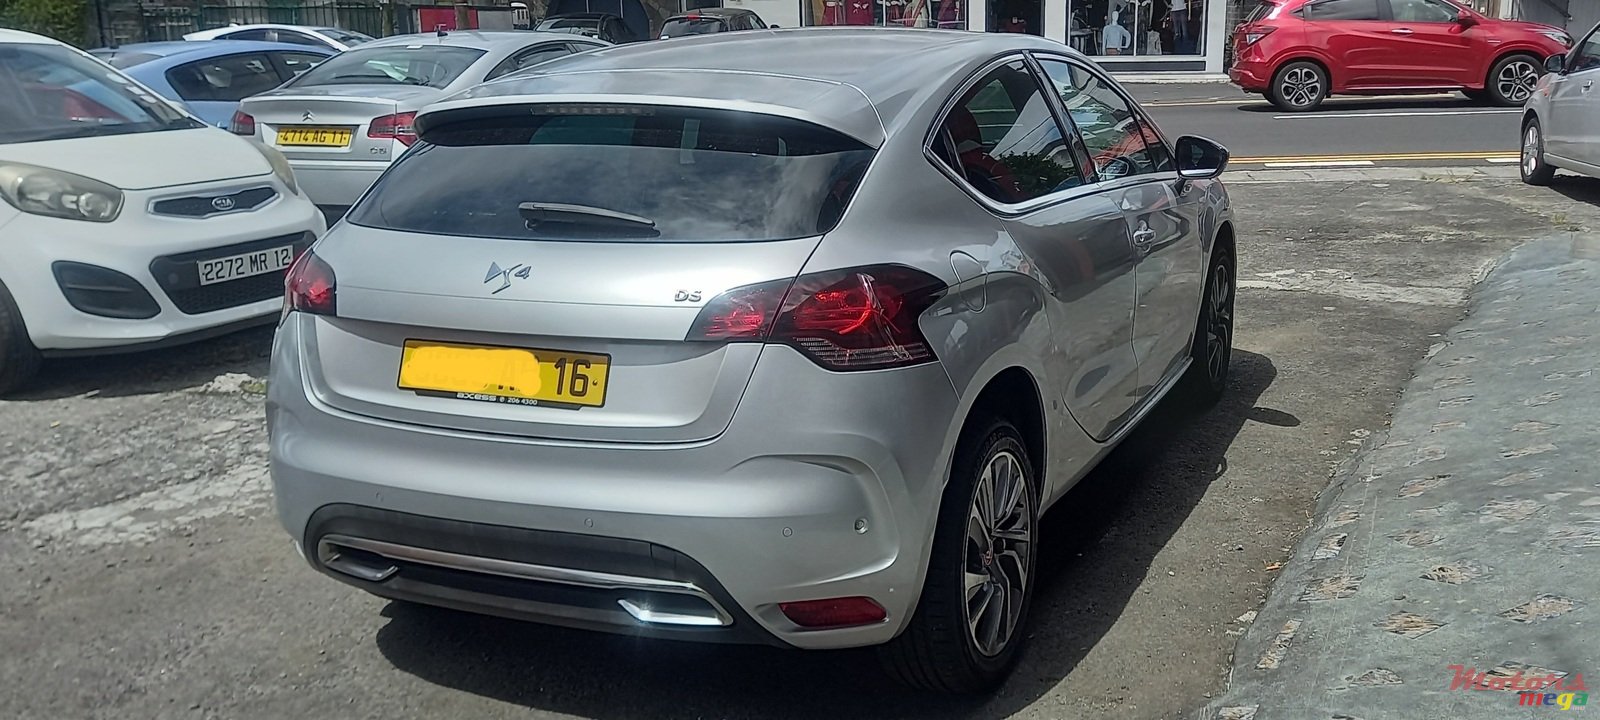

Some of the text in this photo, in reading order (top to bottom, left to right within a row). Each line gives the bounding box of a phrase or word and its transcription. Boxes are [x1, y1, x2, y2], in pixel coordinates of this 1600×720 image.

[282, 129, 343, 144] 4714 AG 11
[214, 198, 233, 208] KIA
[204, 248, 290, 281] 2272 MR 12
[674, 290, 702, 302] DS
[554, 357, 591, 397] 16
